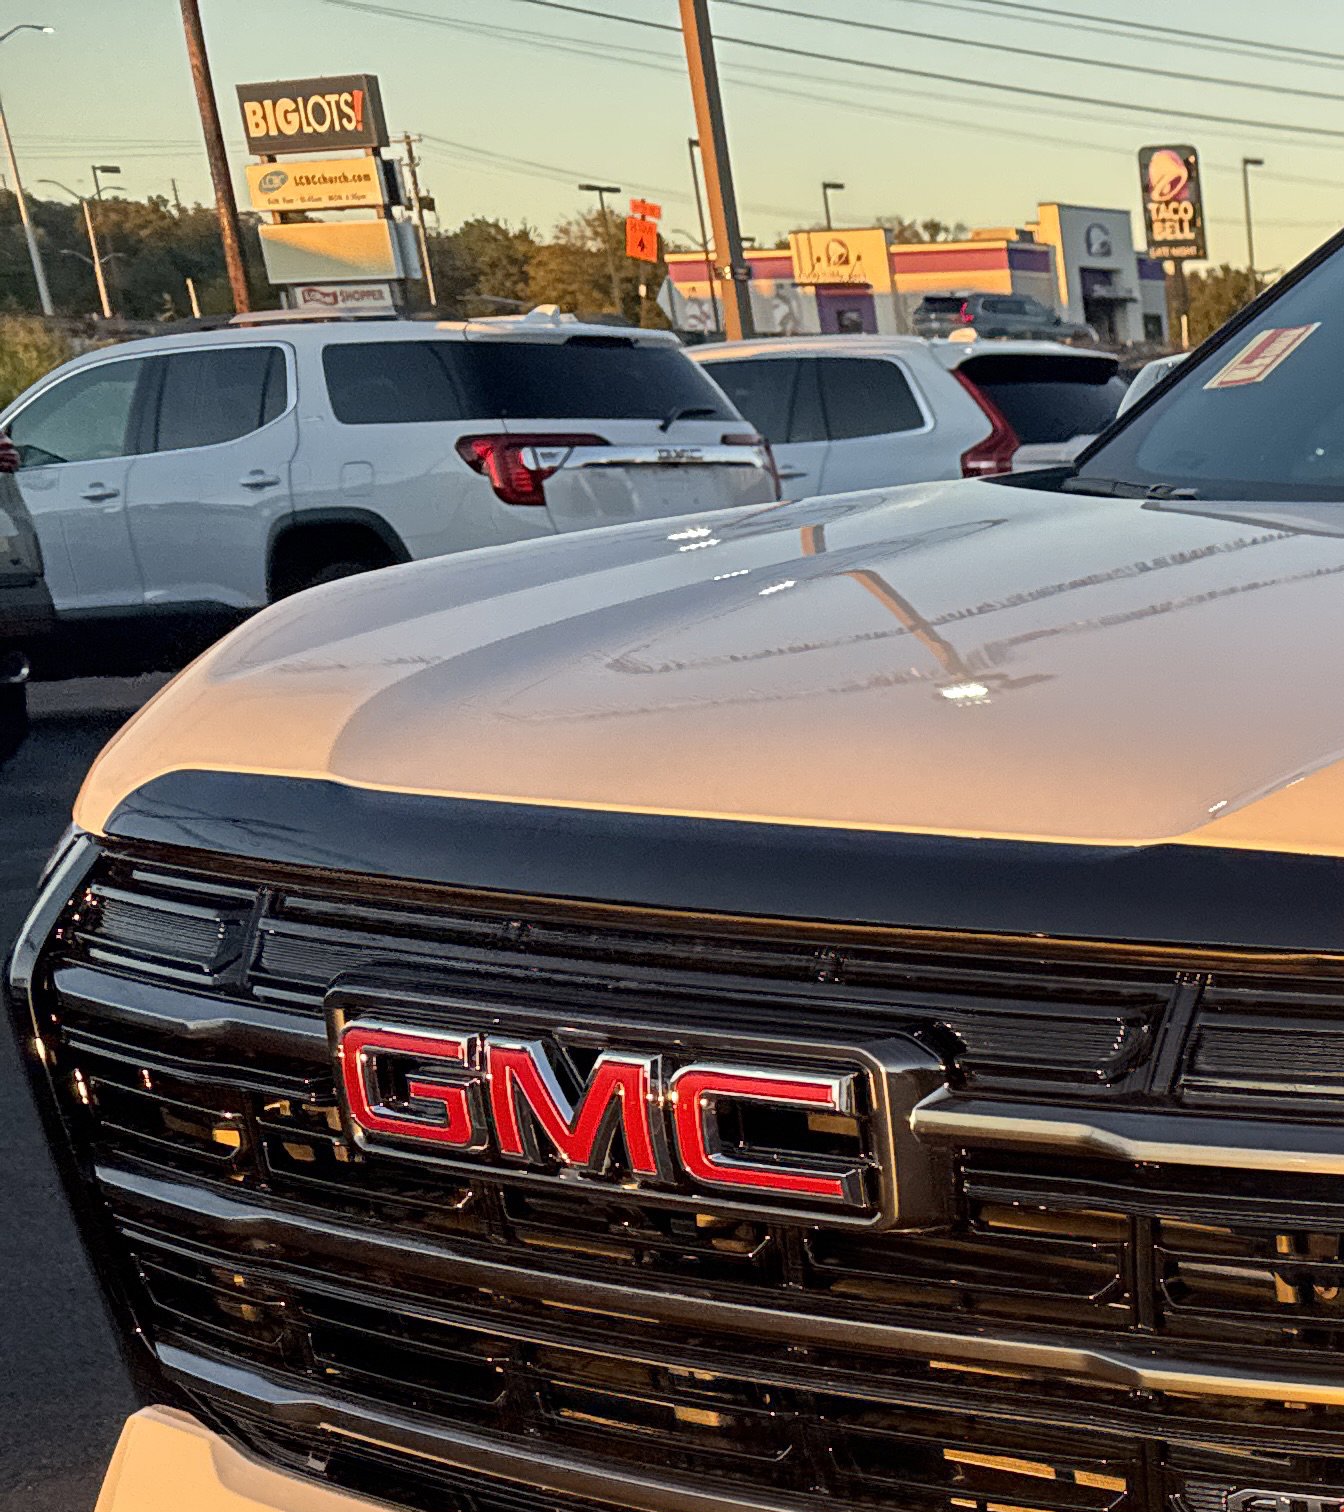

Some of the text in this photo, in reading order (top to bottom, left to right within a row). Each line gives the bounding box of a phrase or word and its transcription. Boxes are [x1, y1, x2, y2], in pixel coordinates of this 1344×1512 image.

[1148, 201, 1194, 221] TACO
[1153, 219, 1195, 241] BELL
[338, 1019, 864, 1205] GMC
